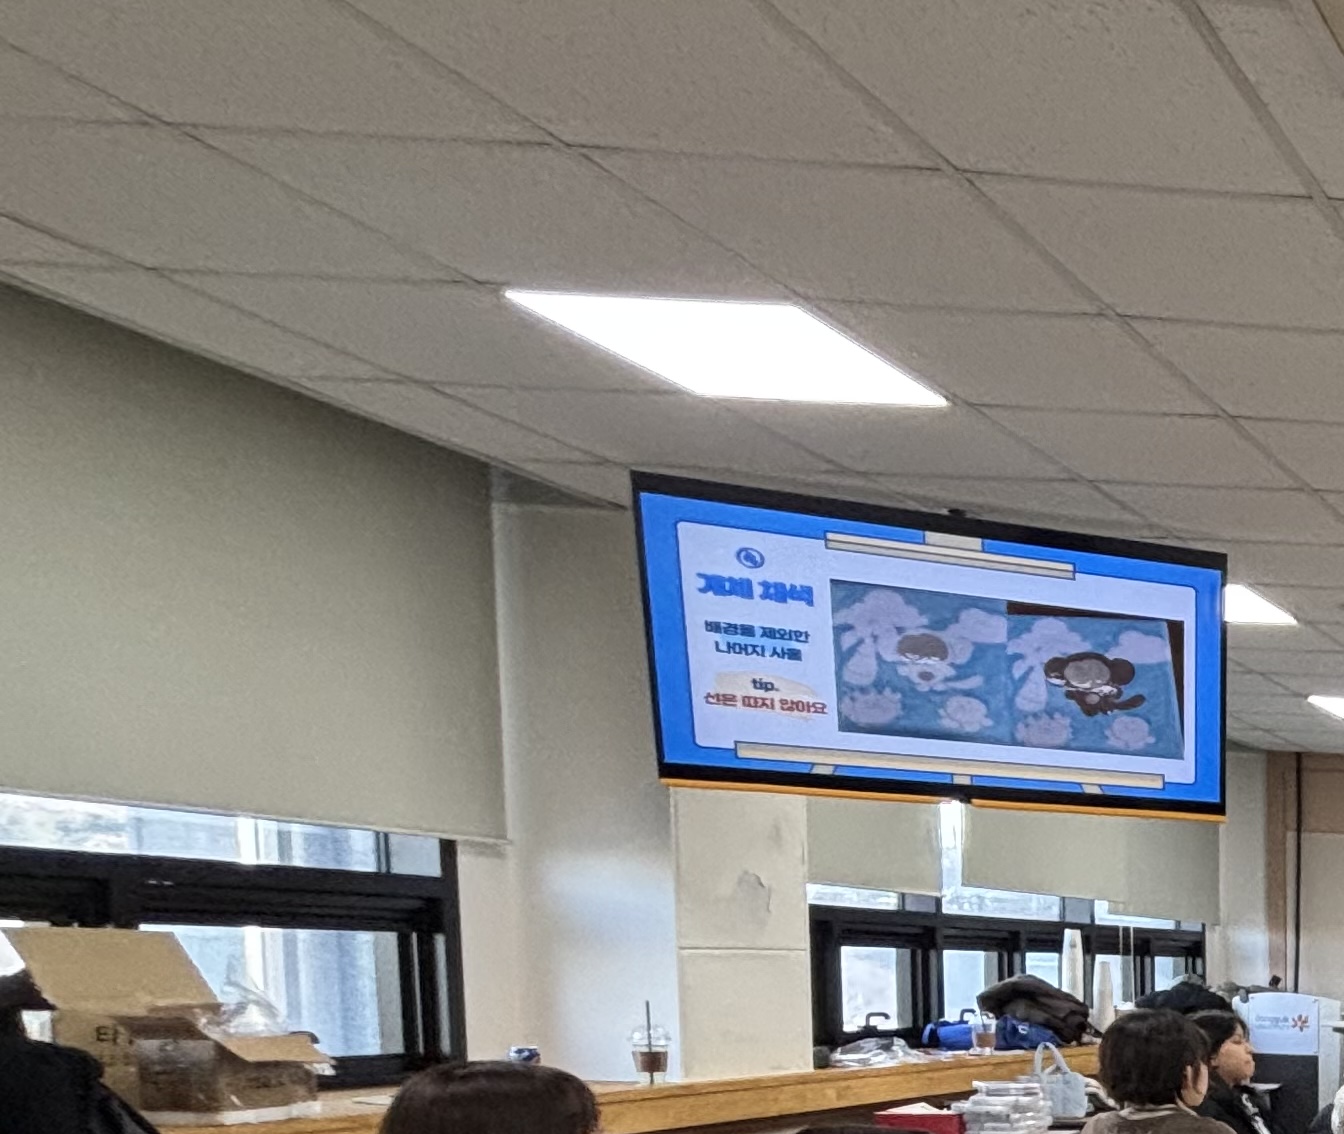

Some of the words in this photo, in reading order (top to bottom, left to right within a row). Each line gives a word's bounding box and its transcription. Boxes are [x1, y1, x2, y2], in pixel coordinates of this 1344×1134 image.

[704, 620, 755, 638] 배경을
[714, 641, 766, 658] 나머지
[751, 678, 779, 692] tip.
[704, 692, 738, 707] 선은
